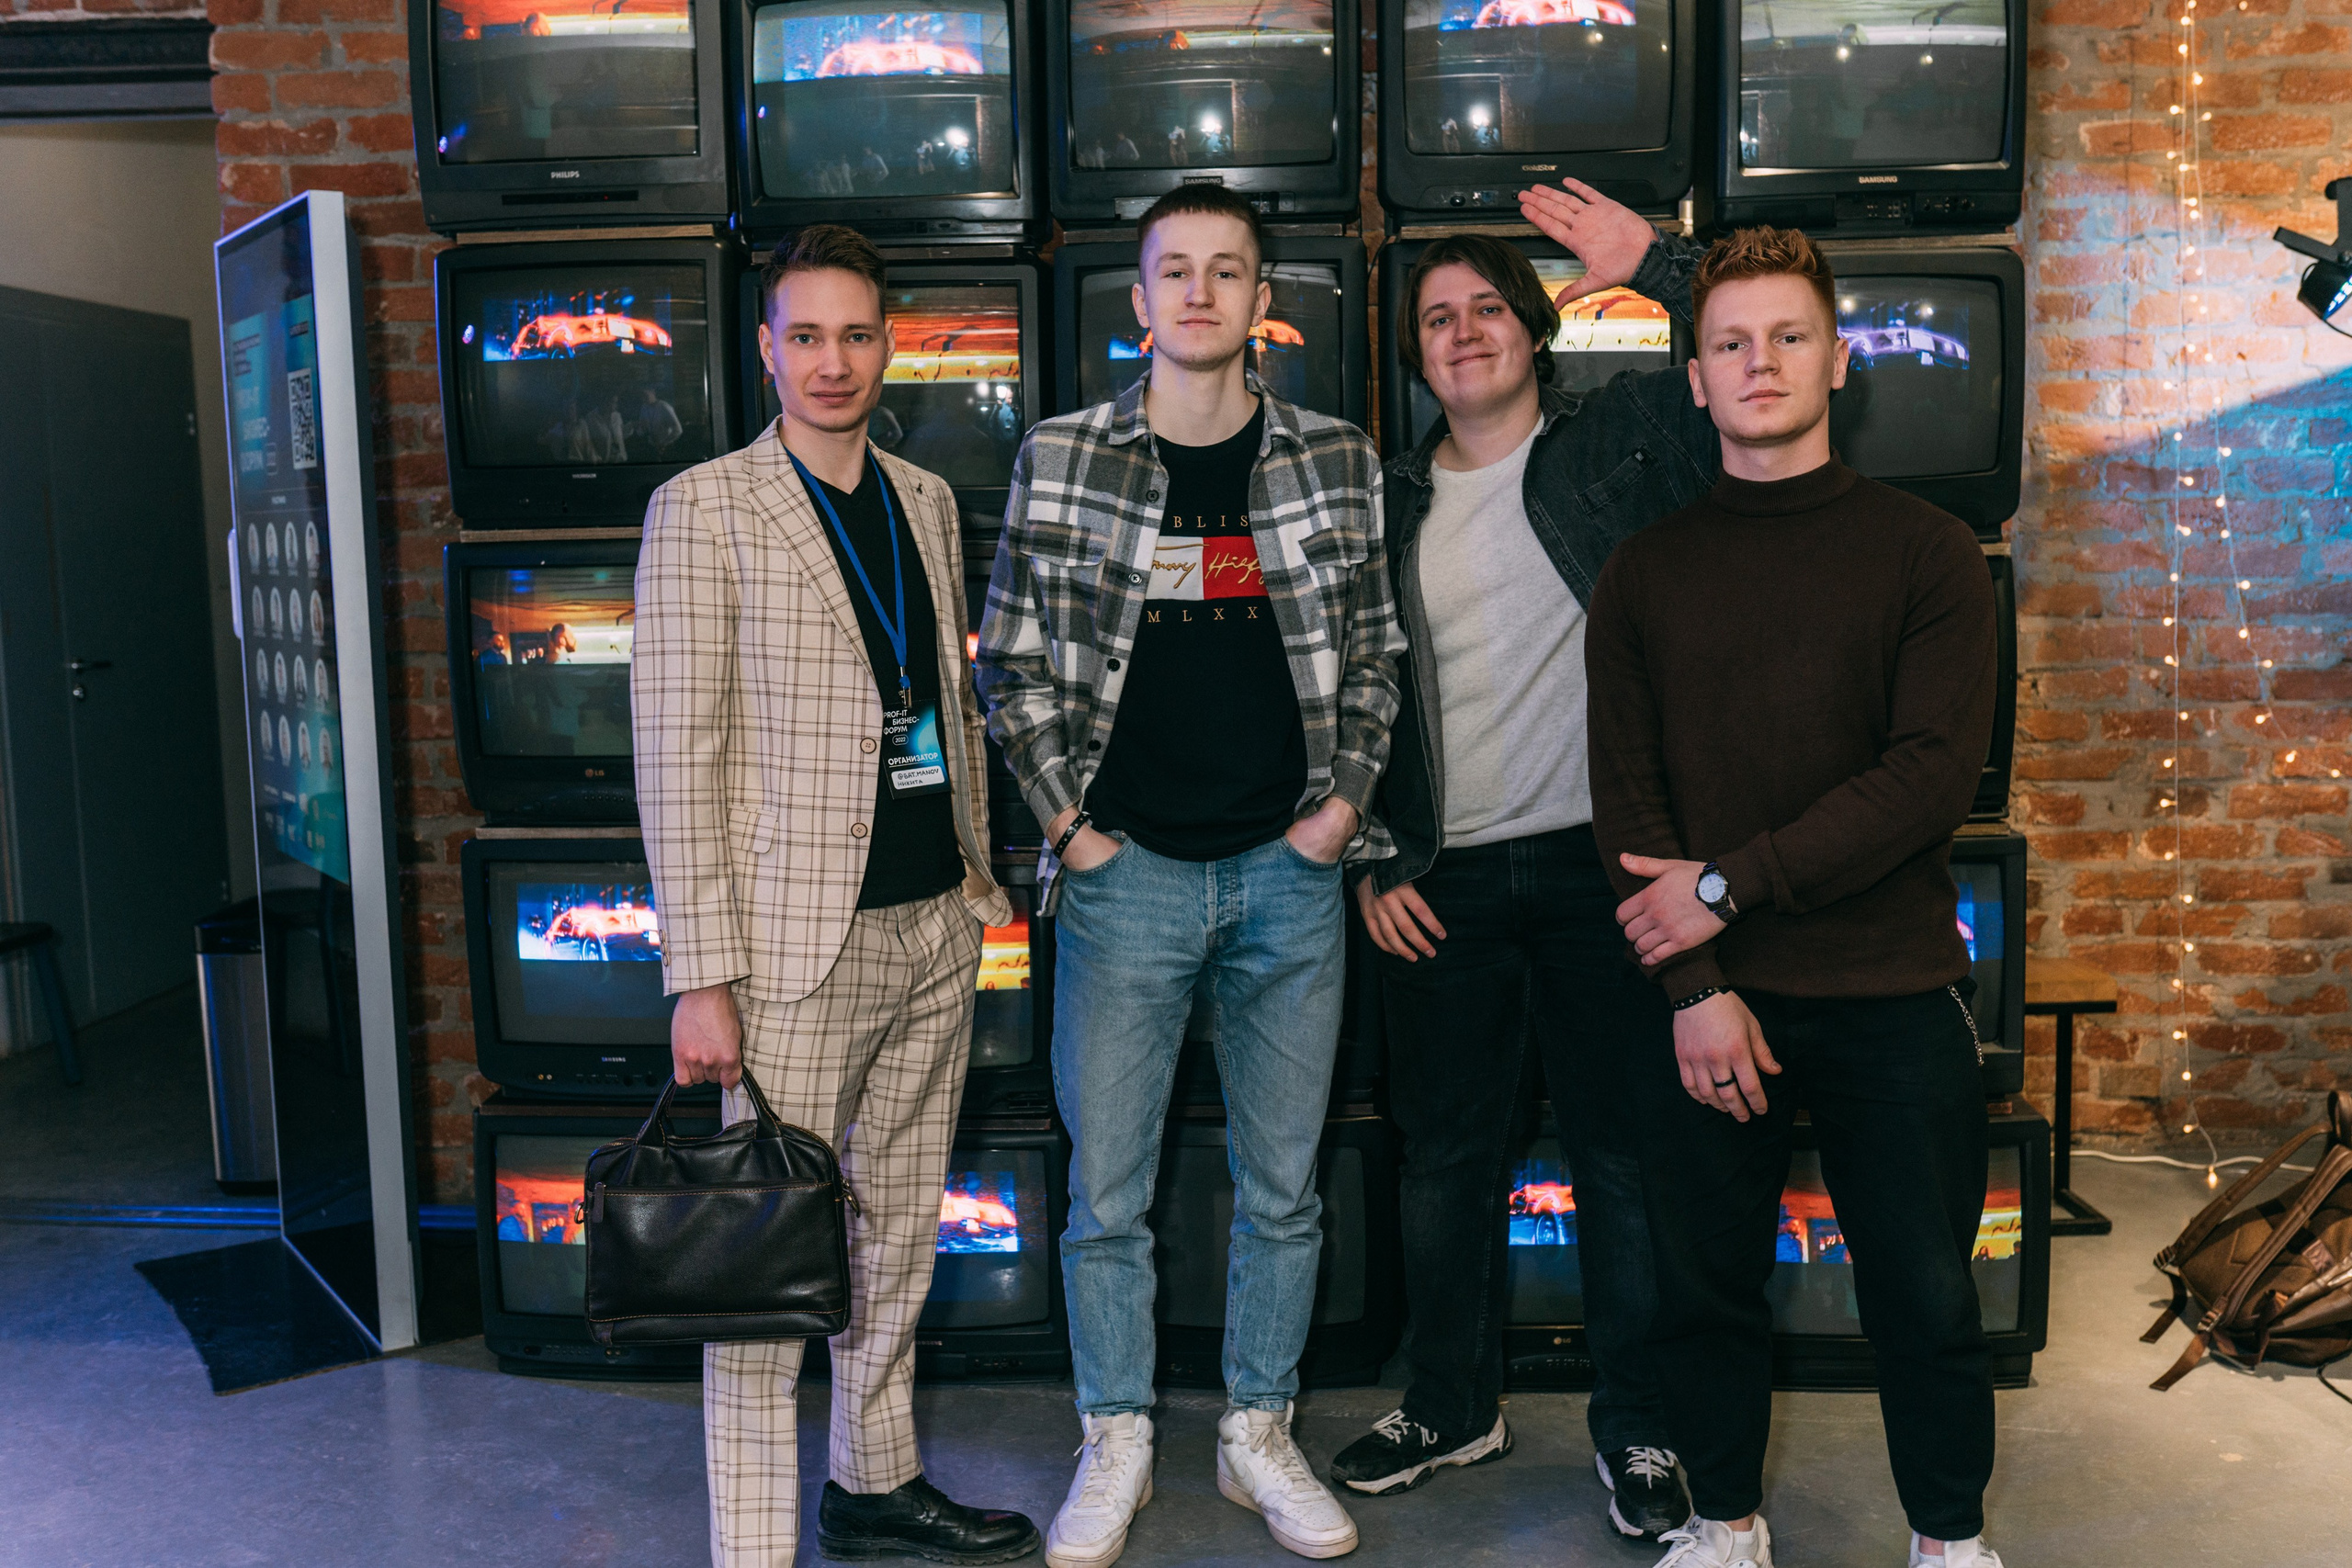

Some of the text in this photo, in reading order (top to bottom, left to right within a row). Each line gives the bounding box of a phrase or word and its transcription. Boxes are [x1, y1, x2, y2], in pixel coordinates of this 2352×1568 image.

[550, 170, 581, 179] PHILIPS
[1858, 175, 1898, 184] SAMSUNG
[883, 709, 908, 718] PROF-IT
[892, 716, 920, 726] БИЗНЕС-
[883, 725, 908, 735] ФОРУМ
[888, 752, 938, 765] ОРГАНИЗАТОР
